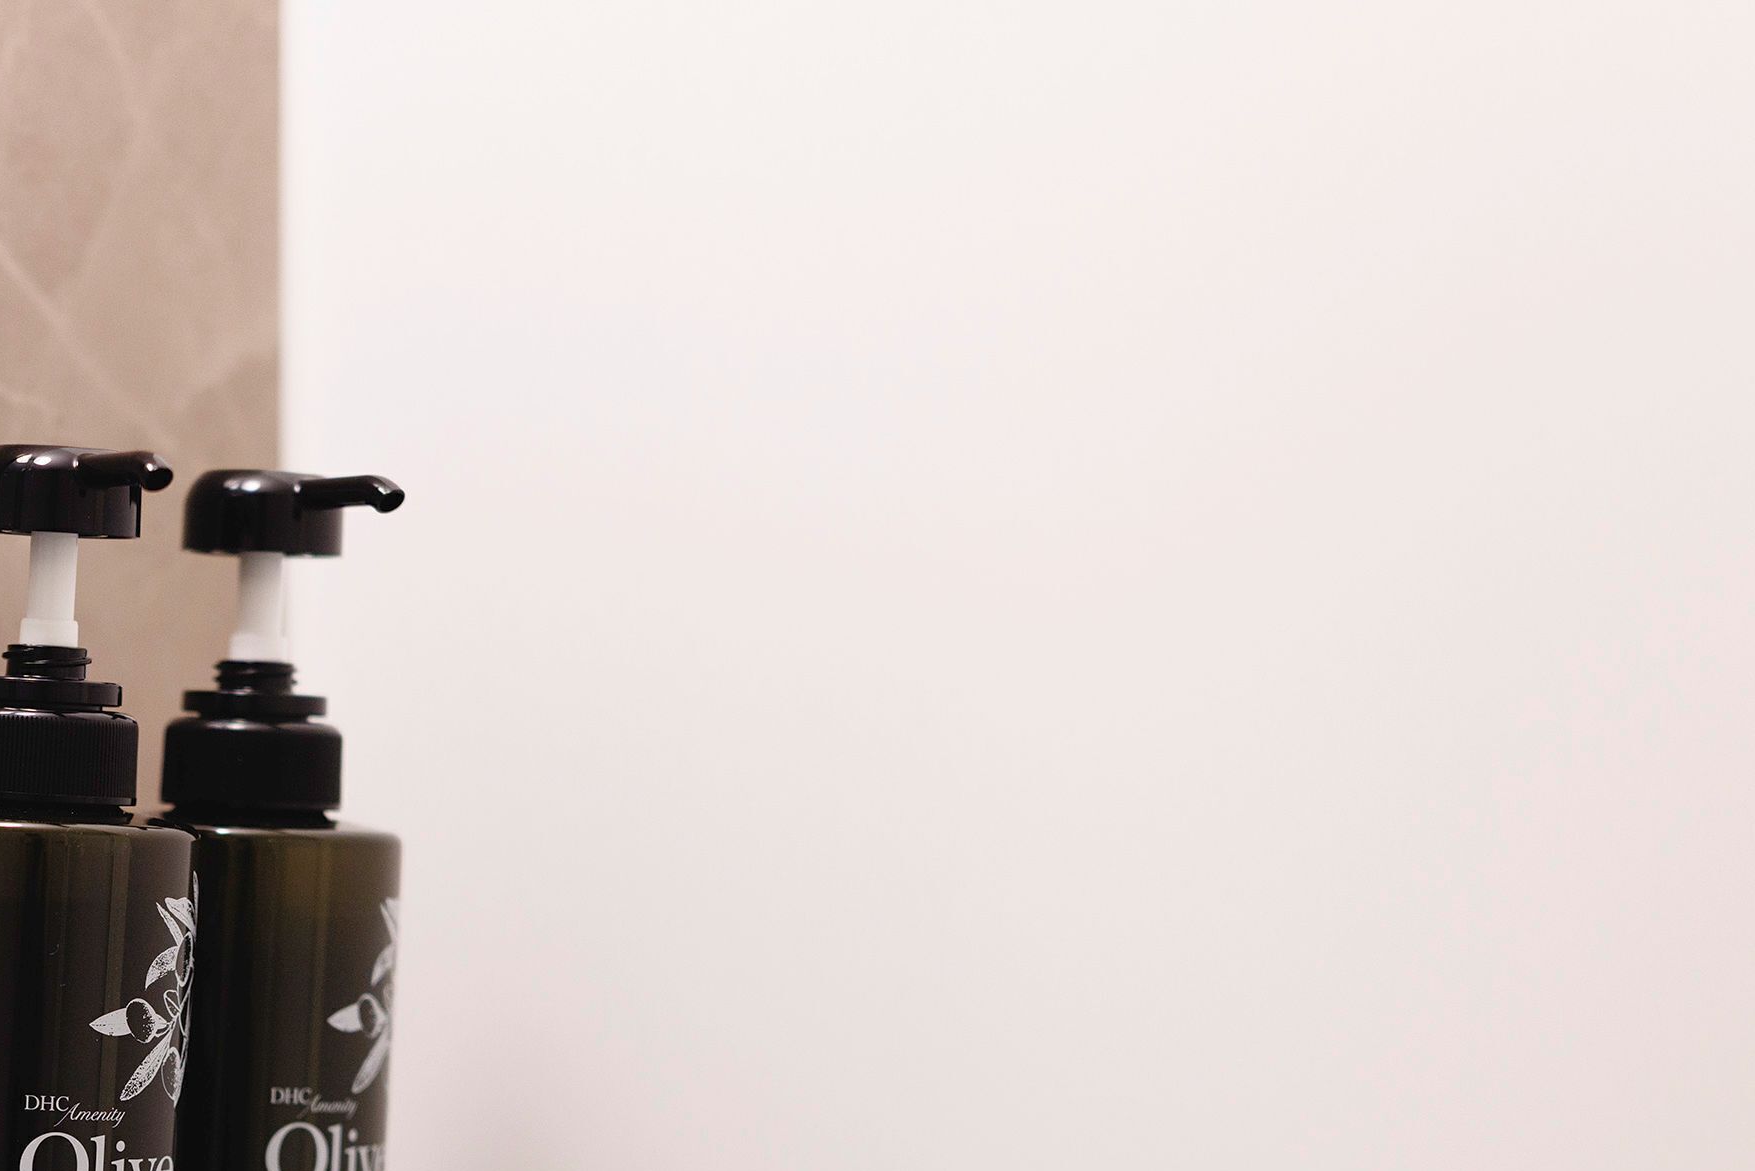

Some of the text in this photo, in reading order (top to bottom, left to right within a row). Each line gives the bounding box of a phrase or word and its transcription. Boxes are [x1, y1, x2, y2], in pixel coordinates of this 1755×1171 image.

[269, 1086, 313, 1105] DHC
[24, 1094, 127, 1129] DHC Amenity
